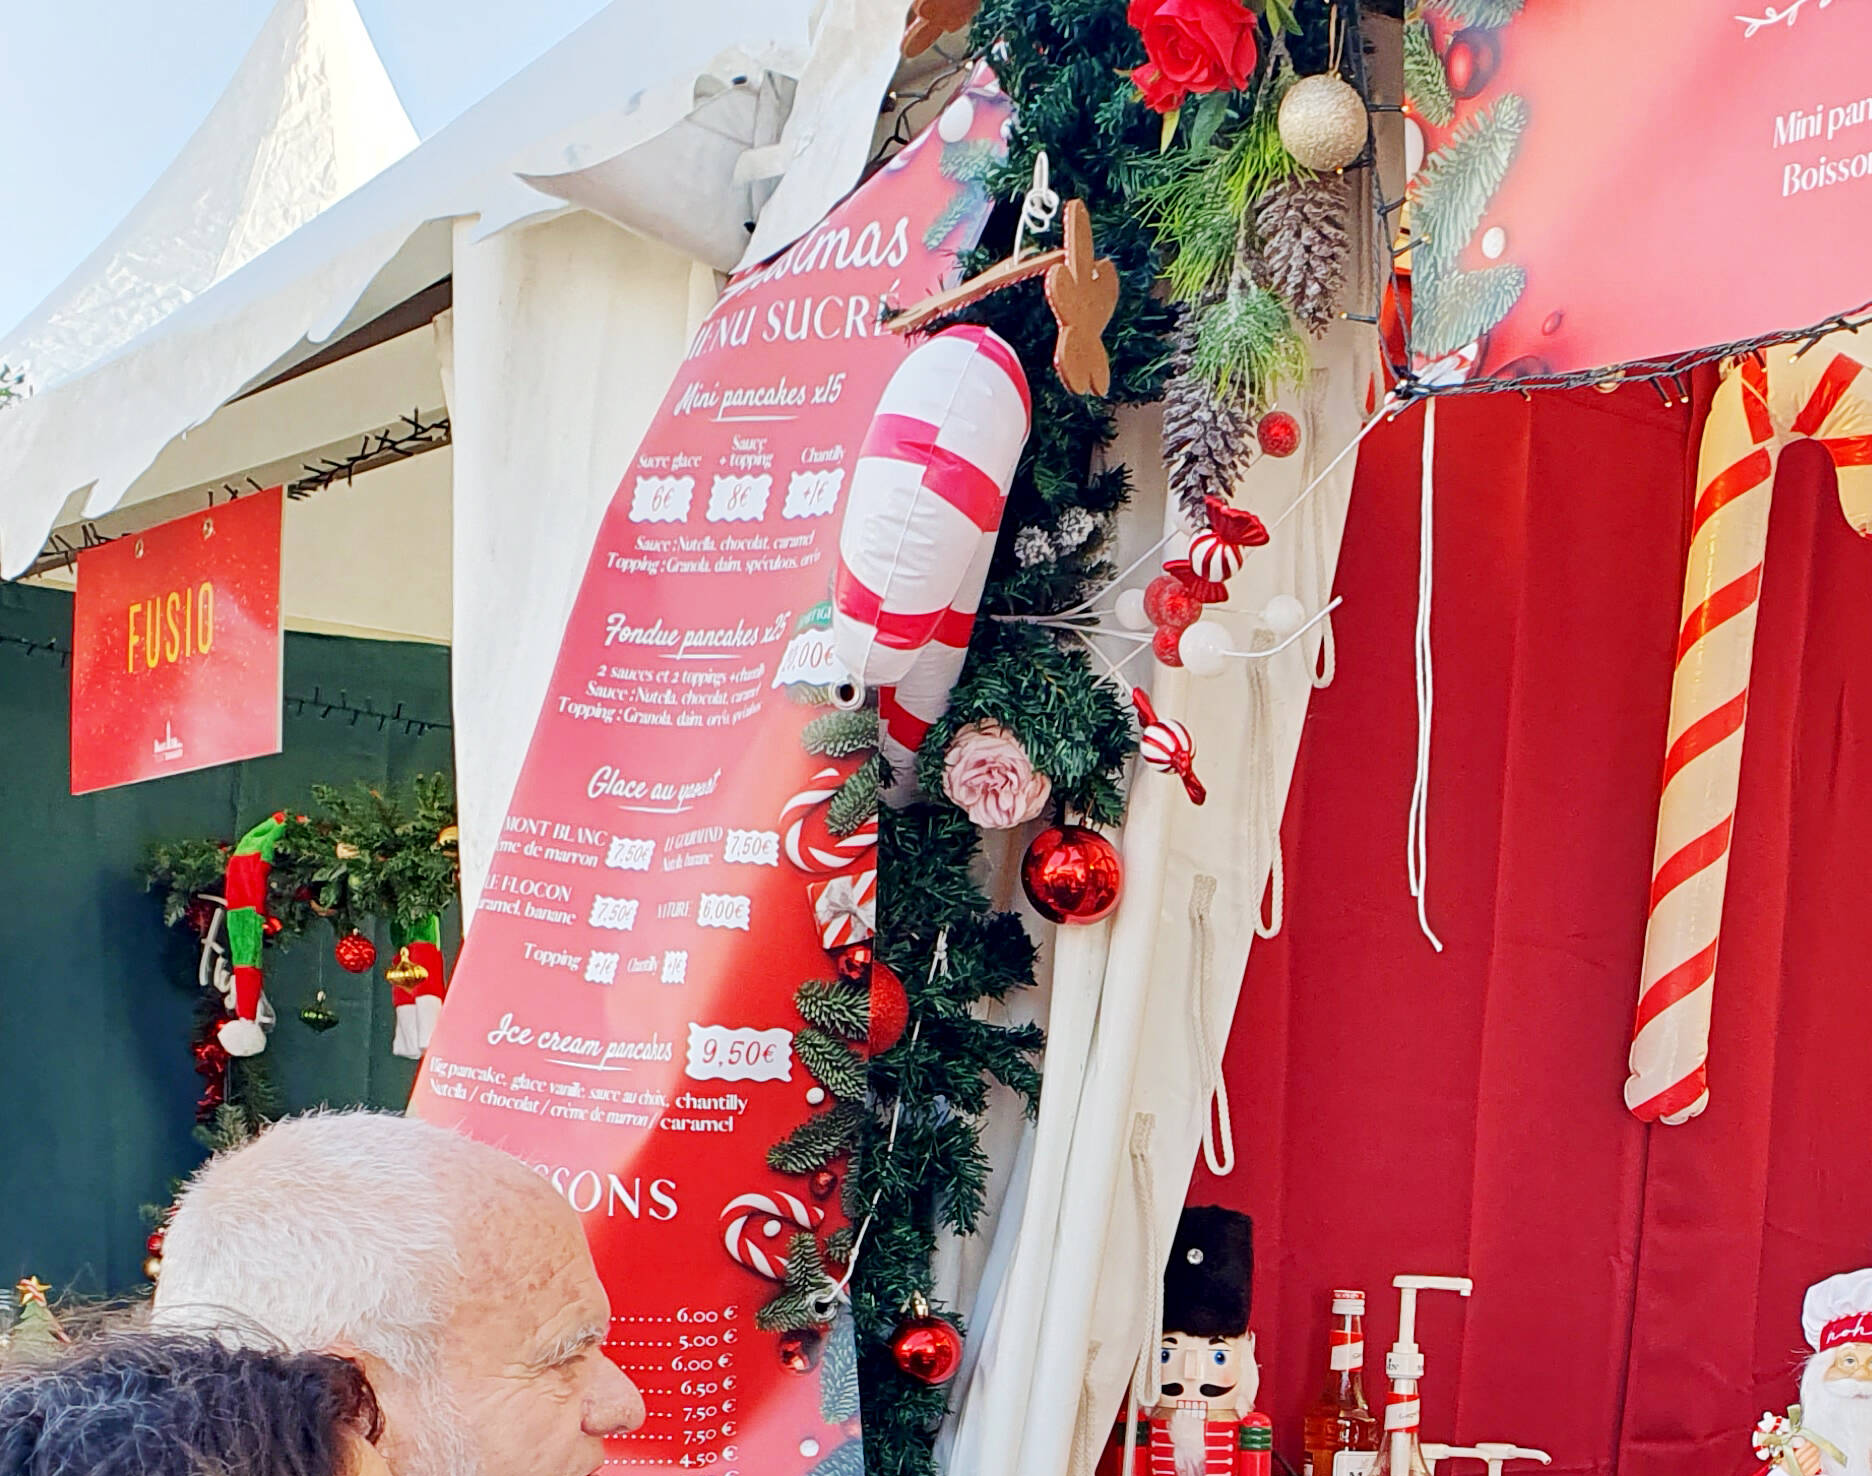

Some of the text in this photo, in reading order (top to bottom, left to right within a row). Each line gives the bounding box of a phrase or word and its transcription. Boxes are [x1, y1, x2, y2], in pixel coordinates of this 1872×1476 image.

[1773, 109, 1822, 149] Mini
[674, 372, 847, 420] Mini pancakes x15
[729, 452, 773, 471] topping
[607, 552, 661, 575] Topping
[128, 581, 215, 673] FUSIO
[604, 612, 680, 646] Fondue
[679, 619, 760, 660] pancakes
[760, 611, 792, 644] x25
[610, 666, 653, 683] sauces
[656, 668, 669, 682] et
[558, 696, 616, 722] Topping
[588, 764, 649, 800] Glace
[649, 788, 676, 801] au
[523, 840, 543, 858] de
[544, 847, 599, 868] marron
[730, 835, 771, 856] 7,50€
[501, 875, 572, 902] FLOCON
[524, 901, 576, 926] banane
[702, 900, 745, 920] 6,00€
[523, 942, 582, 972] Topping
[487, 1012, 673, 1070] Ice cream pancakes
[702, 1037, 778, 1069] 9,50€
[510, 1073, 547, 1092] glace
[675, 1092, 748, 1115] chantilly
[480, 1089, 540, 1113] chocolat
[659, 1116, 734, 1133] caramel
[676, 1306, 719, 1324] 6.00
[678, 1329, 719, 1351] 5.00
[671, 1354, 714, 1372] 6.00
[680, 1380, 718, 1398] 6.50
[682, 1404, 718, 1422] 7.50
[682, 1427, 717, 1446] 7.50
[680, 1451, 718, 1469] 4.50
